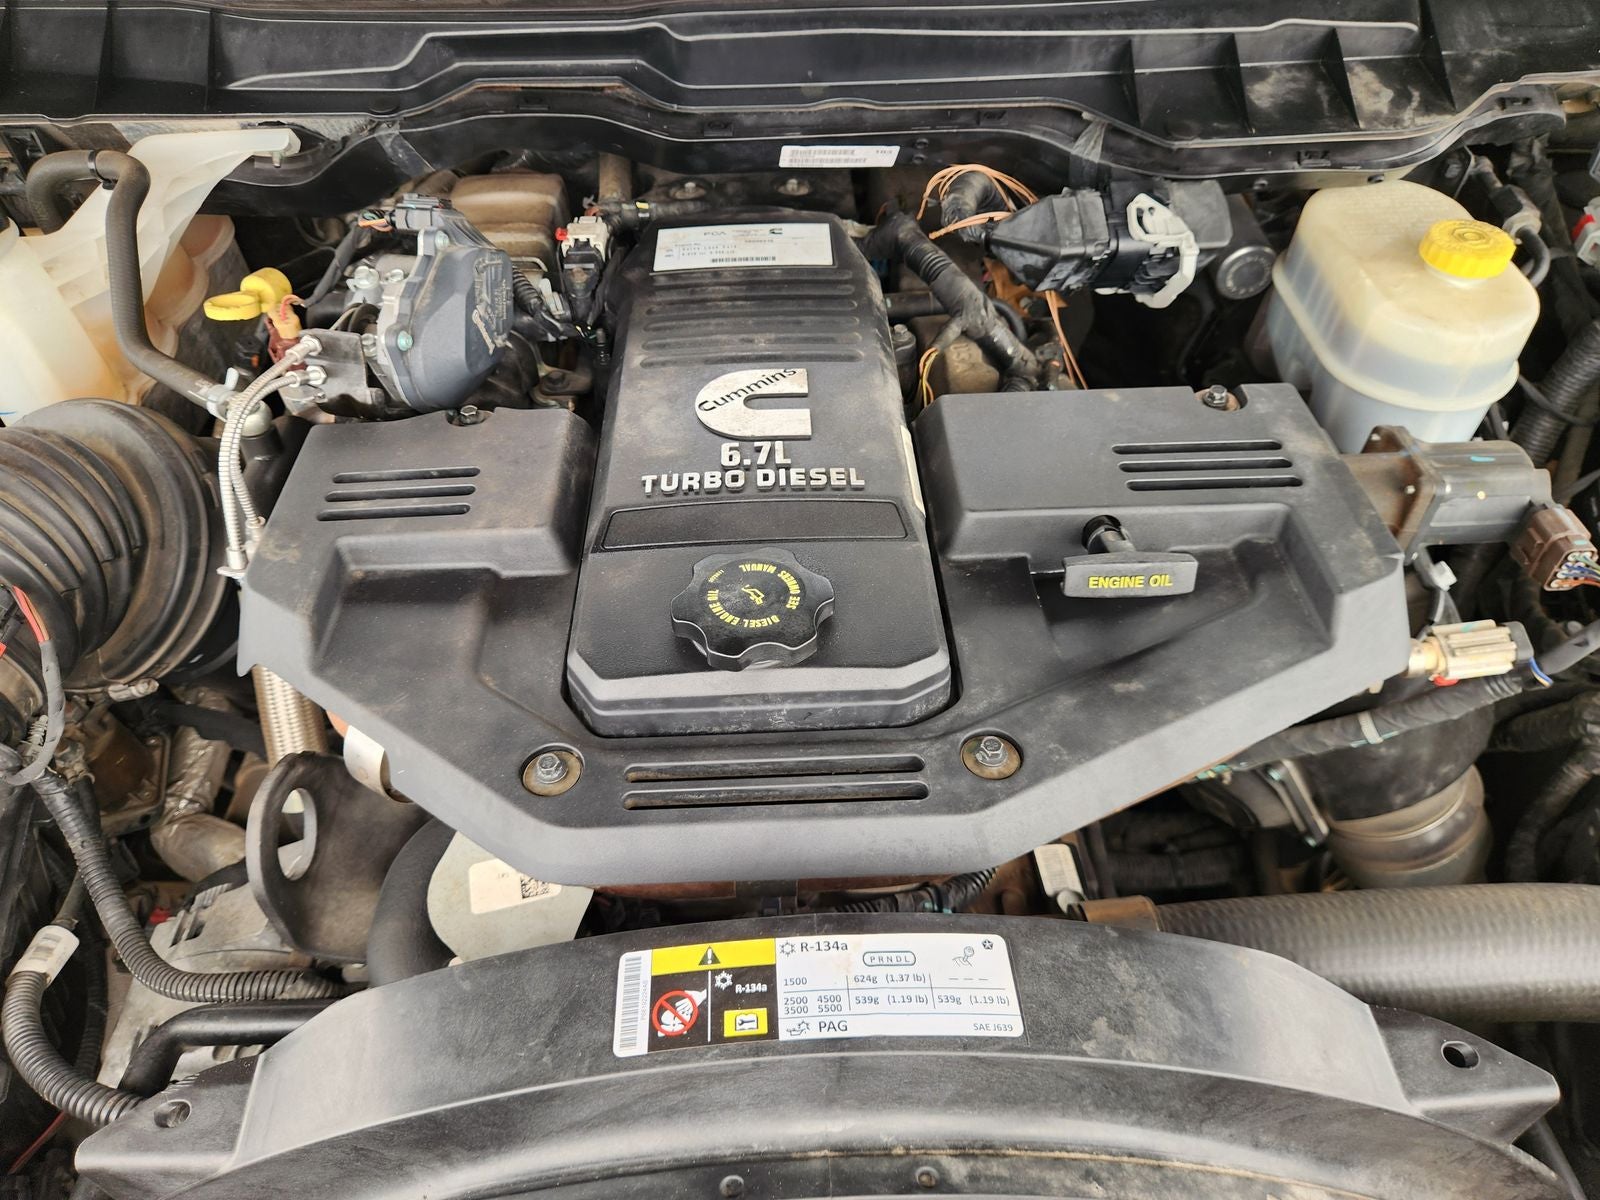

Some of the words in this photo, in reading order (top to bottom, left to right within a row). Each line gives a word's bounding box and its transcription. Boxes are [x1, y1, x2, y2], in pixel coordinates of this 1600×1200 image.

[698, 367, 798, 412] Cummins
[720, 440, 792, 470] 6.7L
[641, 469, 746, 497] TURBO
[756, 467, 866, 490] DIESEL
[739, 563, 777, 574] MANUAL
[1088, 575, 1145, 589] ENGINE
[1149, 574, 1173, 587] OIL
[707, 589, 719, 602] OIL
[785, 596, 801, 610] SEE
[708, 603, 740, 626] ENGINE
[743, 614, 781, 628] DIESEL
[800, 940, 848, 952] R-134a
[783, 976, 808, 986] 1500
[853, 974, 878, 985] 624g
[885, 973, 912, 984] (1.37
[913, 973, 927, 983] lb)
[735, 982, 768, 993] R-134a
[783, 996, 808, 1005] 2500
[816, 994, 842, 1004] 4500
[855, 995, 880, 1006] 539g
[887, 994, 914, 1005] (1.19
[915, 994, 929, 1004] lb)
[937, 995, 962, 1006] 539g
[969, 995, 995, 1006] (1.19
[996, 995, 1010, 1006] lb)
[783, 1005, 809, 1014] 3500
[817, 1004, 843, 1013] 5500
[818, 1020, 848, 1032] PAG
[973, 1023, 992, 1032] SAE
[993, 1023, 1013, 1033] J639
